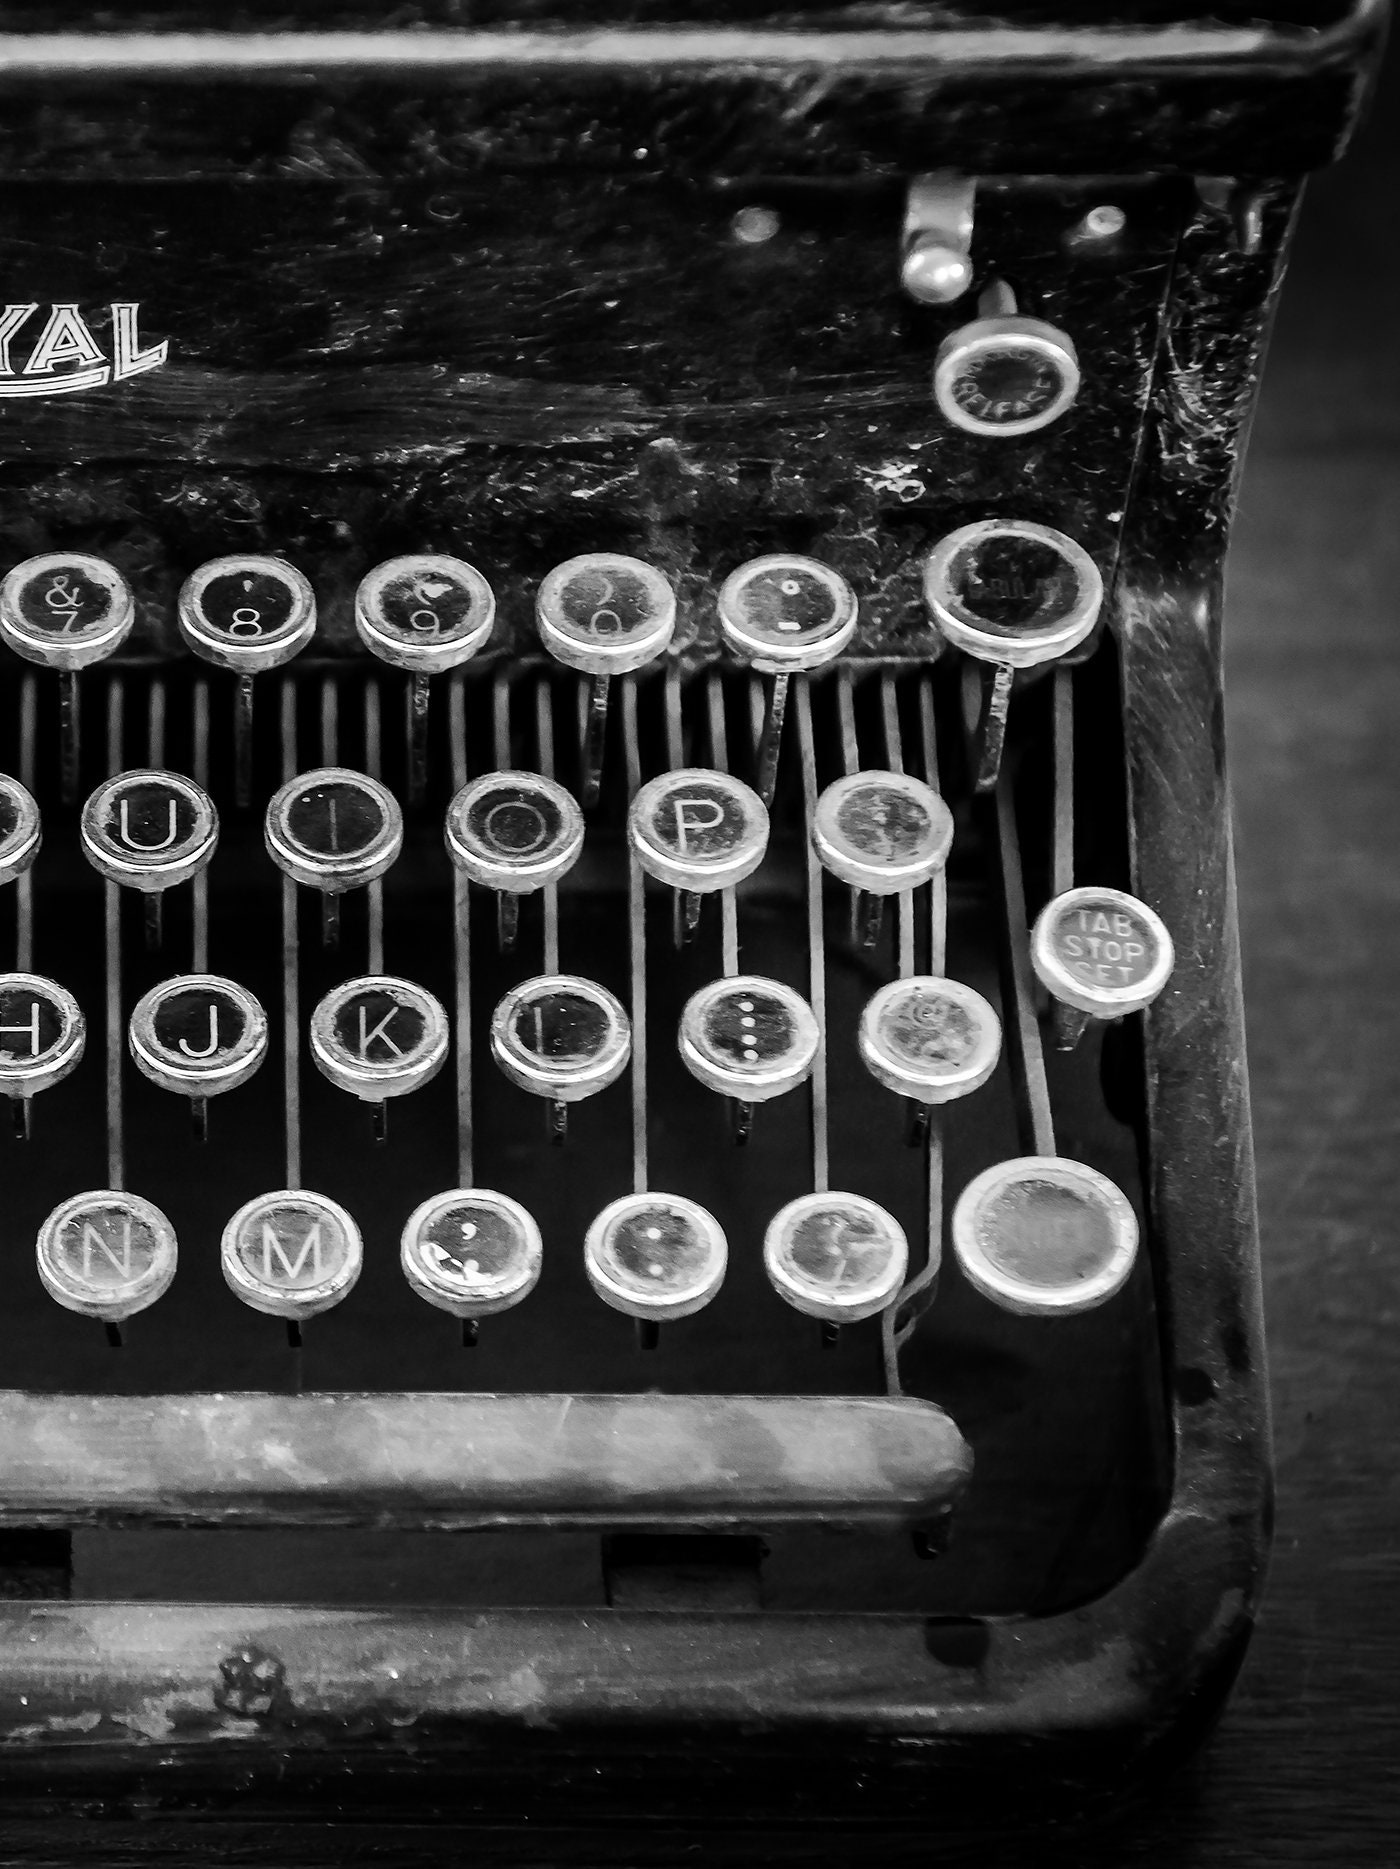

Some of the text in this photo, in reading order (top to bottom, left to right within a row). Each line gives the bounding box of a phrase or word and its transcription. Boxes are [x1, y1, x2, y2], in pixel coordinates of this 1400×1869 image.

[44, 575, 85, 609] &
[51, 611, 78, 632] 7
[229, 607, 263, 637] 8
[409, 609, 440, 636] 9
[119, 799, 177, 851] U
[330, 798, 338, 851] I
[486, 801, 547, 851] O
[674, 799, 725, 856] P
[1063, 935, 1144, 962] STOP
[1078, 909, 1132, 937] TAB
[178, 1004, 219, 1058] J
[359, 1006, 405, 1059] K
[83, 1221, 131, 1280] N
[262, 1222, 321, 1279] M
